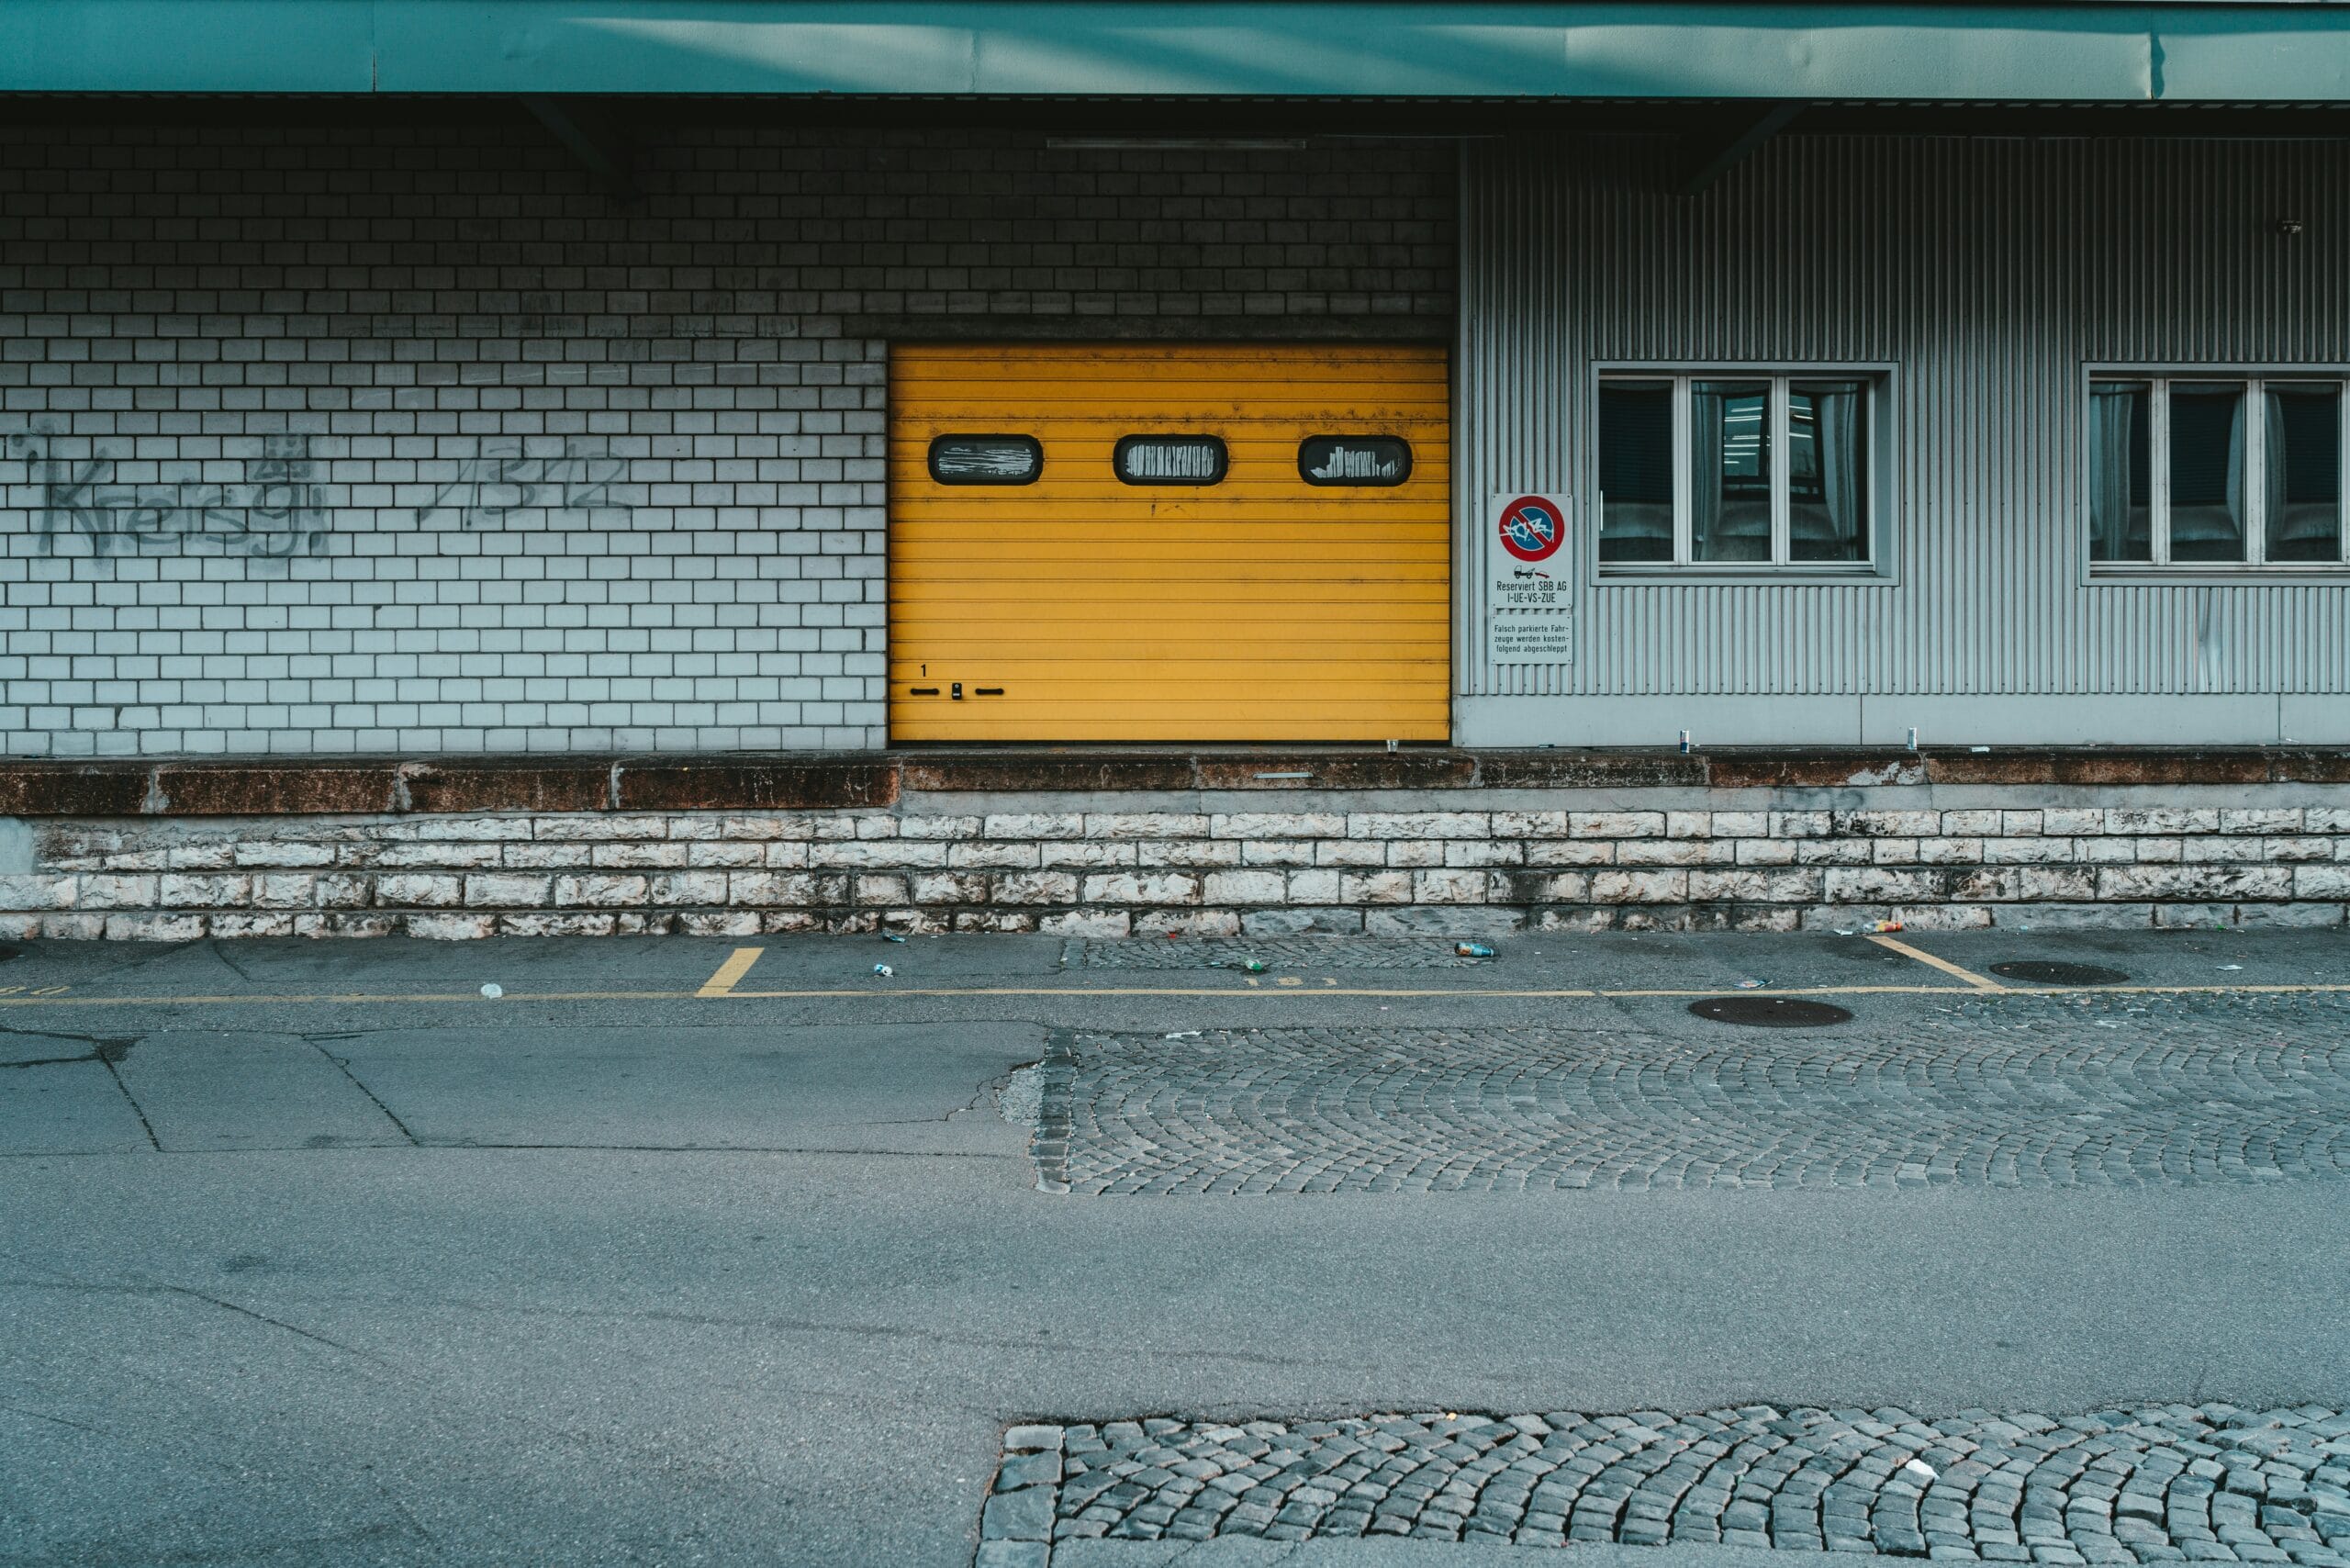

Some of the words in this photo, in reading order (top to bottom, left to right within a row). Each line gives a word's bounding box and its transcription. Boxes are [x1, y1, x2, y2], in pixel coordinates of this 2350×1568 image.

[1496, 580, 1536, 591] Reserviert
[1538, 580, 1554, 591] SBB
[1556, 580, 1567, 591] AG
[1507, 592, 1556, 603] I-UE-VS-ZUE
[1494, 624, 1516, 633] Falsch
[1517, 624, 1549, 633] parkierte
[1550, 624, 1570, 633] Fahr-
[1516, 634, 1540, 643] werden
[1543, 634, 1570, 643] kosten-
[1496, 644, 1521, 654] folgend
[1523, 644, 1567, 654] abgeschleppt
[920, 664, 926, 678] 1
